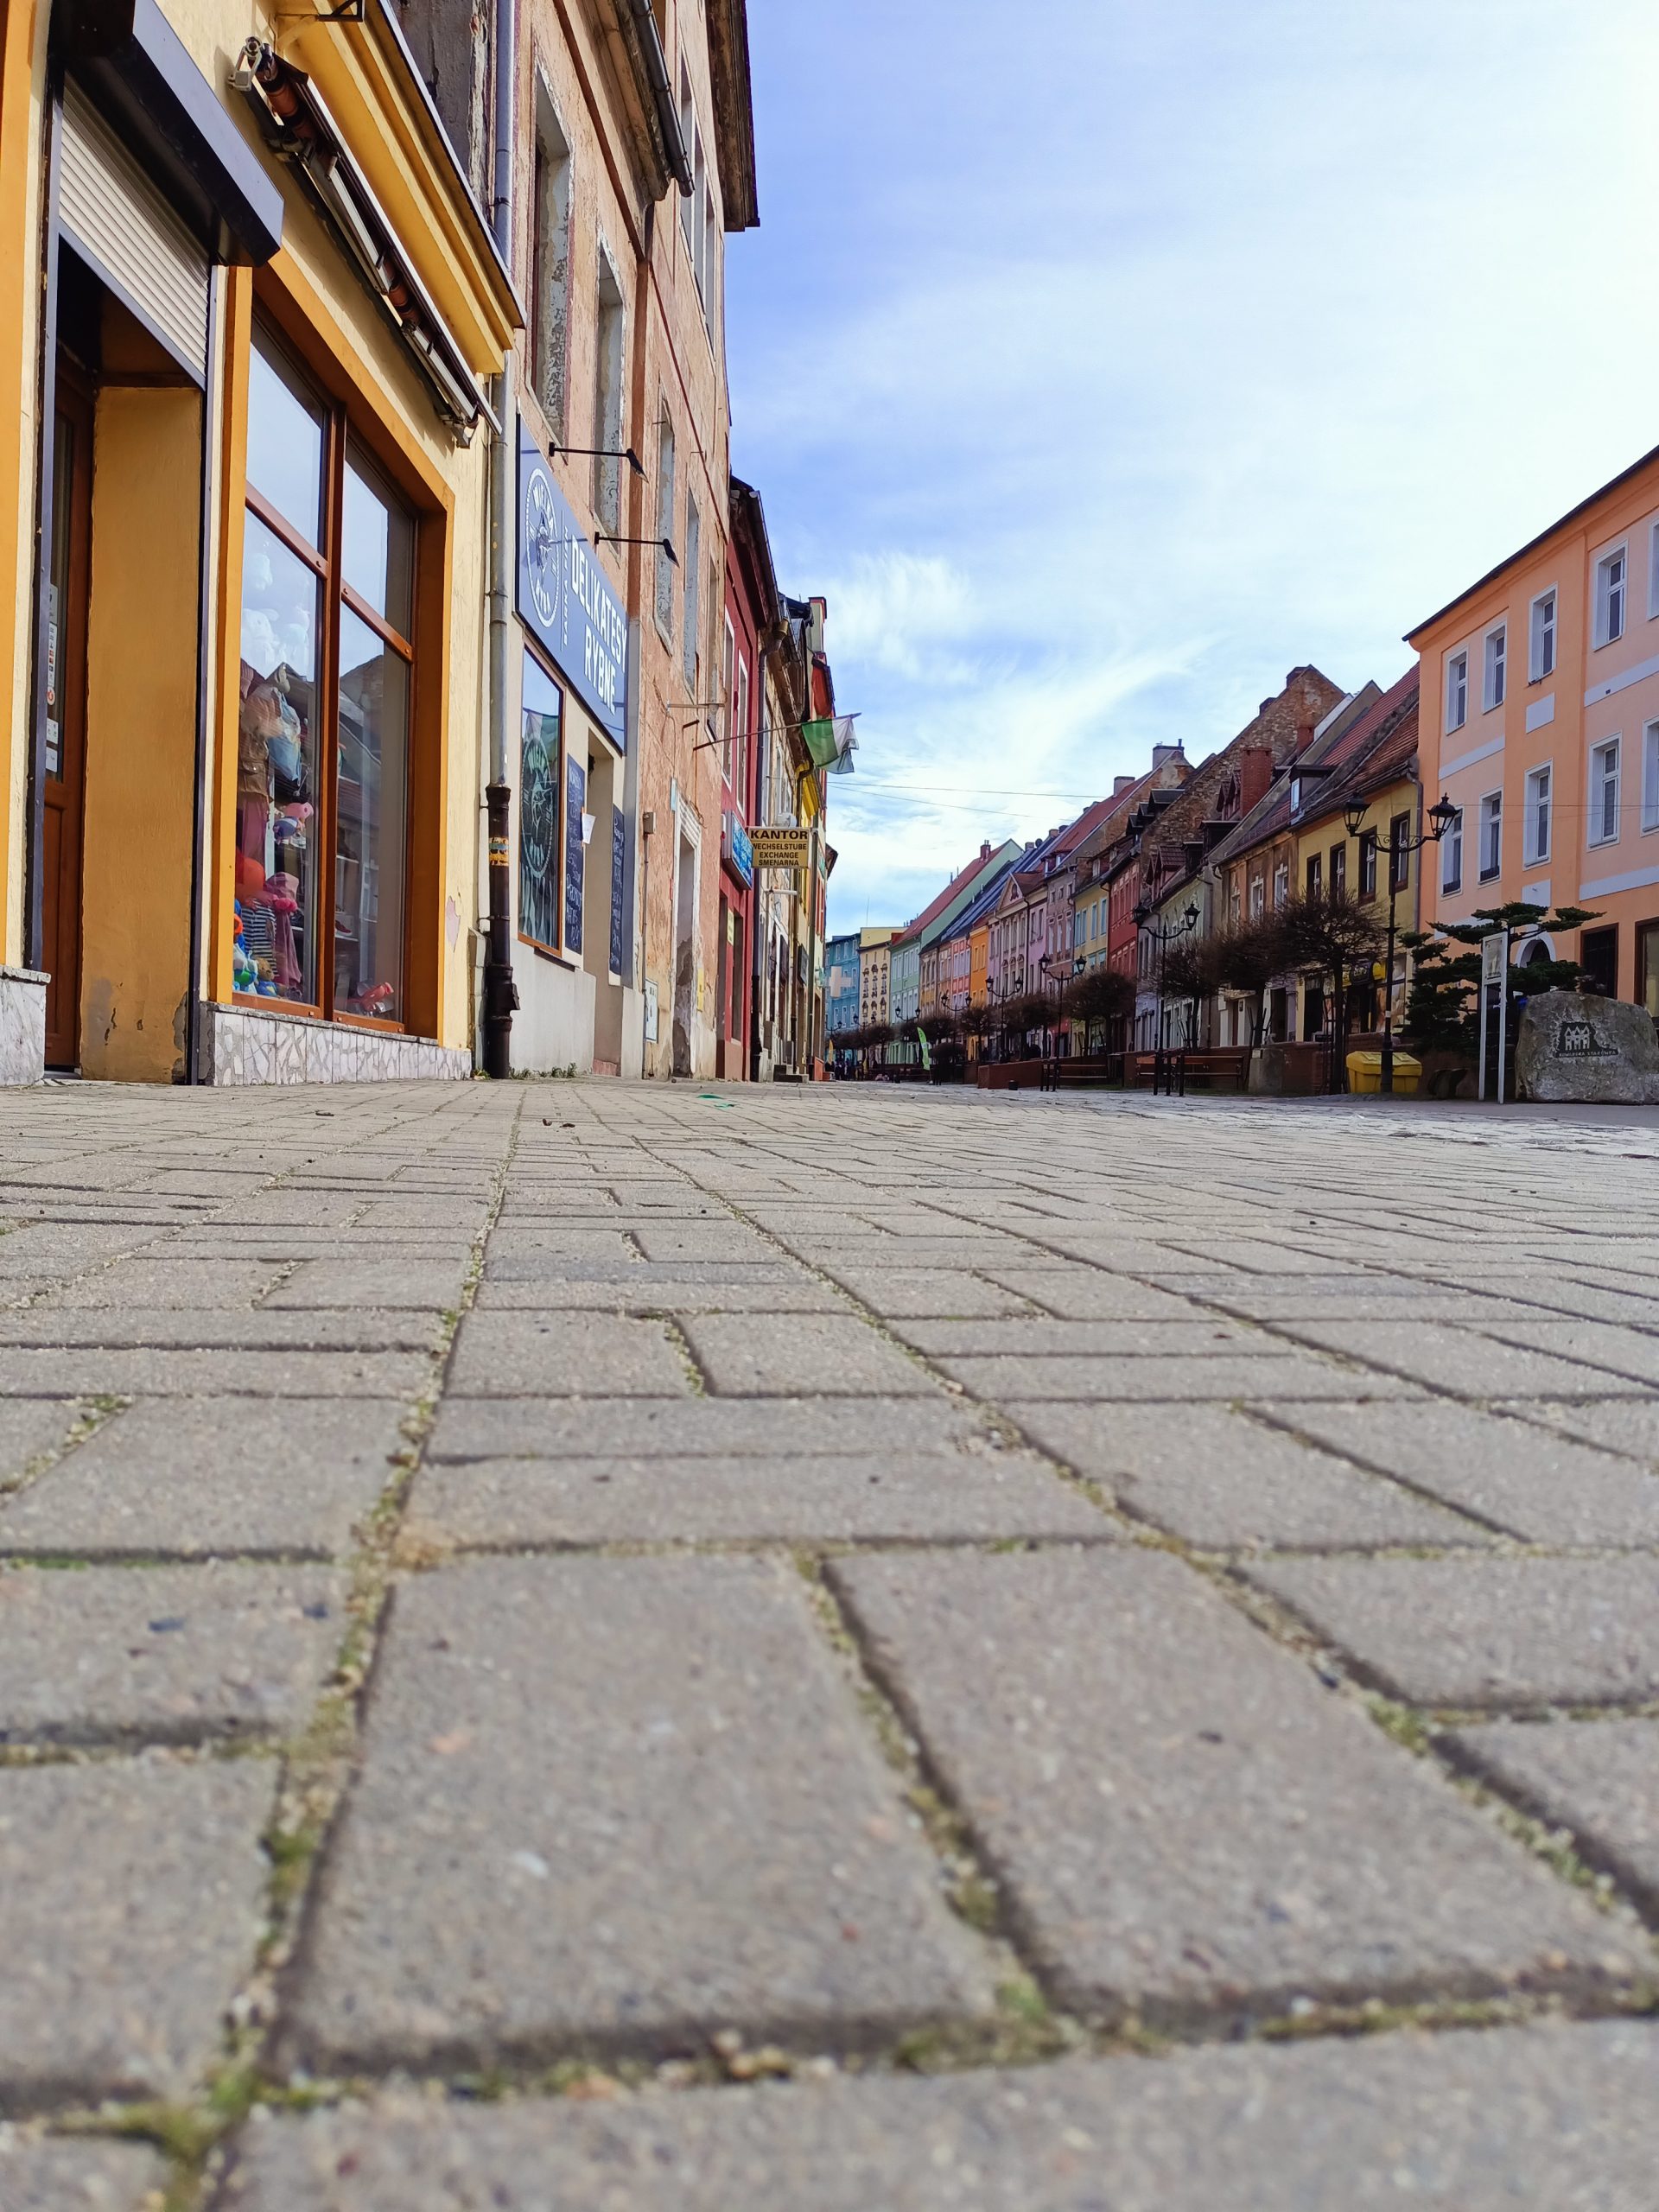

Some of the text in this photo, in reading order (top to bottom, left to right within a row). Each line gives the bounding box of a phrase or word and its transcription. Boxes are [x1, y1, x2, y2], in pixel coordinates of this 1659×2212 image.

[571, 534, 627, 673] DELIKATESY
[585, 623, 616, 716] RYBNE
[750, 830, 808, 840] KANTOR
